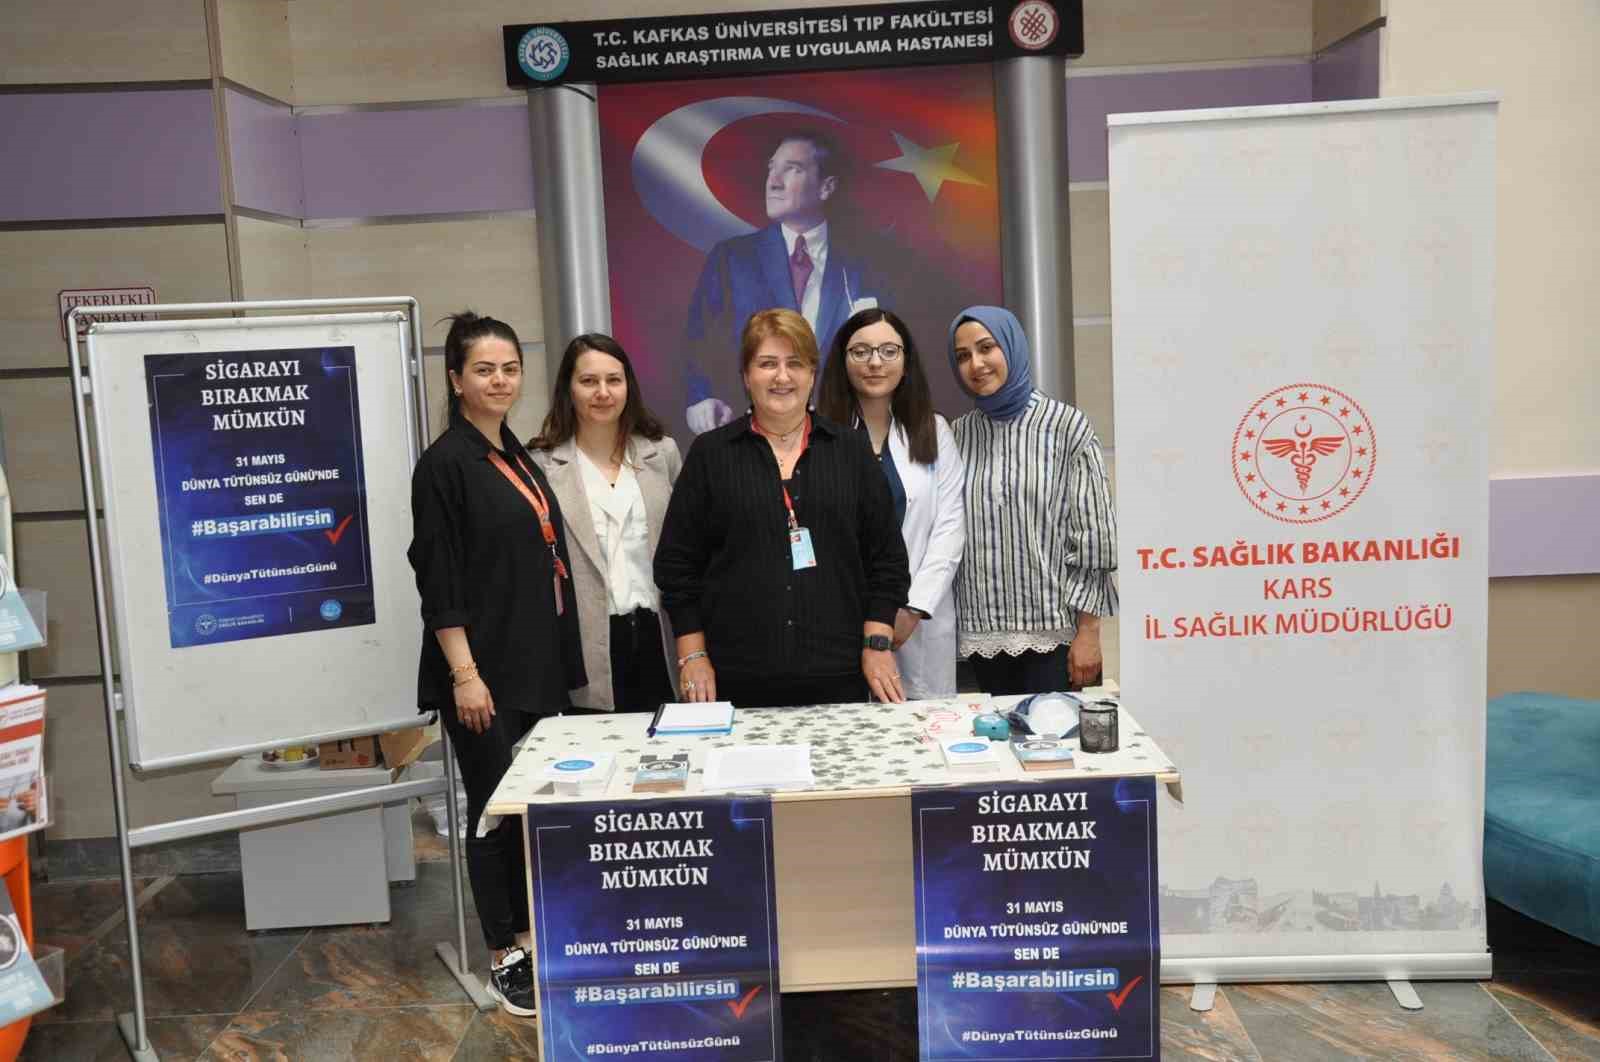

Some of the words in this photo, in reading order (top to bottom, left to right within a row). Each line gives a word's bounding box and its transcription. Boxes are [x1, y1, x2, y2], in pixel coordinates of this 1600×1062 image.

[593, 32, 627, 46] T.C.
[633, 26, 709, 44] KAFKAS
[715, 15, 848, 39] ÜNİVERSİTESİ
[854, 16, 884, 31] TIP
[891, 7, 993, 30] FAKÜLTESİ
[596, 52, 659, 68] SAĞLIK
[664, 47, 764, 65] ARAŞTIRMA
[768, 44, 791, 58] VE
[796, 39, 892, 56] UYGULAMA
[897, 31, 993, 51] HASTANESİ
[206, 360, 300, 380] SİGARAYI
[201, 384, 309, 406] BIRAKMAK
[213, 409, 306, 430] MÜMKÜN
[236, 456, 248, 467] 31
[251, 454, 285, 466] MAYIS
[181, 478, 220, 491] DÜNYA
[223, 472, 282, 487] TÜTÜNSÜZ
[244, 494, 266, 506] SEN
[269, 493, 284, 504] DE
[191, 510, 331, 537] #Başarabilirsin
[1137, 547, 1186, 570] T.C.
[1193, 540, 1295, 568] SAĞLIK
[1302, 532, 1460, 564] BAKANLIĞI
[204, 562, 337, 584] #DünyaTütünsüzGünü
[1264, 577, 1332, 600] KARS
[1144, 614, 1166, 639] İL
[1174, 611, 1267, 638] SAĞLIK
[1275, 603, 1452, 635] MÜDÜRLÜĞÜ
[978, 790, 1088, 814] SİGARAYI
[594, 809, 704, 833] SİGARAYI
[971, 821, 1096, 844] BIRAKMAK
[588, 839, 714, 862] BIRAKMAK
[983, 848, 1091, 872] MÜMKÜN
[601, 864, 709, 890] MÜMKÜN
[1006, 902, 1020, 914] 31
[1024, 901, 1064, 913] MAYIS
[626, 919, 640, 930] 31
[645, 917, 683, 929] MAYIS
[944, 925, 987, 939] DÜNYA
[991, 922, 1059, 937] TÜTÜNSÜZ
[565, 941, 608, 956] DÜNYA
[611, 938, 678, 953] TÜTÜNSÜZ
[1014, 948, 1040, 960] SEN
[1043, 947, 1060, 959] DE
[635, 963, 660, 975] SEN
[663, 962, 680, 974] DE
[952, 969, 1115, 992] #Başarabilirsin
[574, 980, 736, 1004] #Başarabilirsin
[587, 1036, 740, 1055] #DünyaTütünsüzGünü
[962, 1028, 1117, 1044] #DünyaTütünsüzGünü
